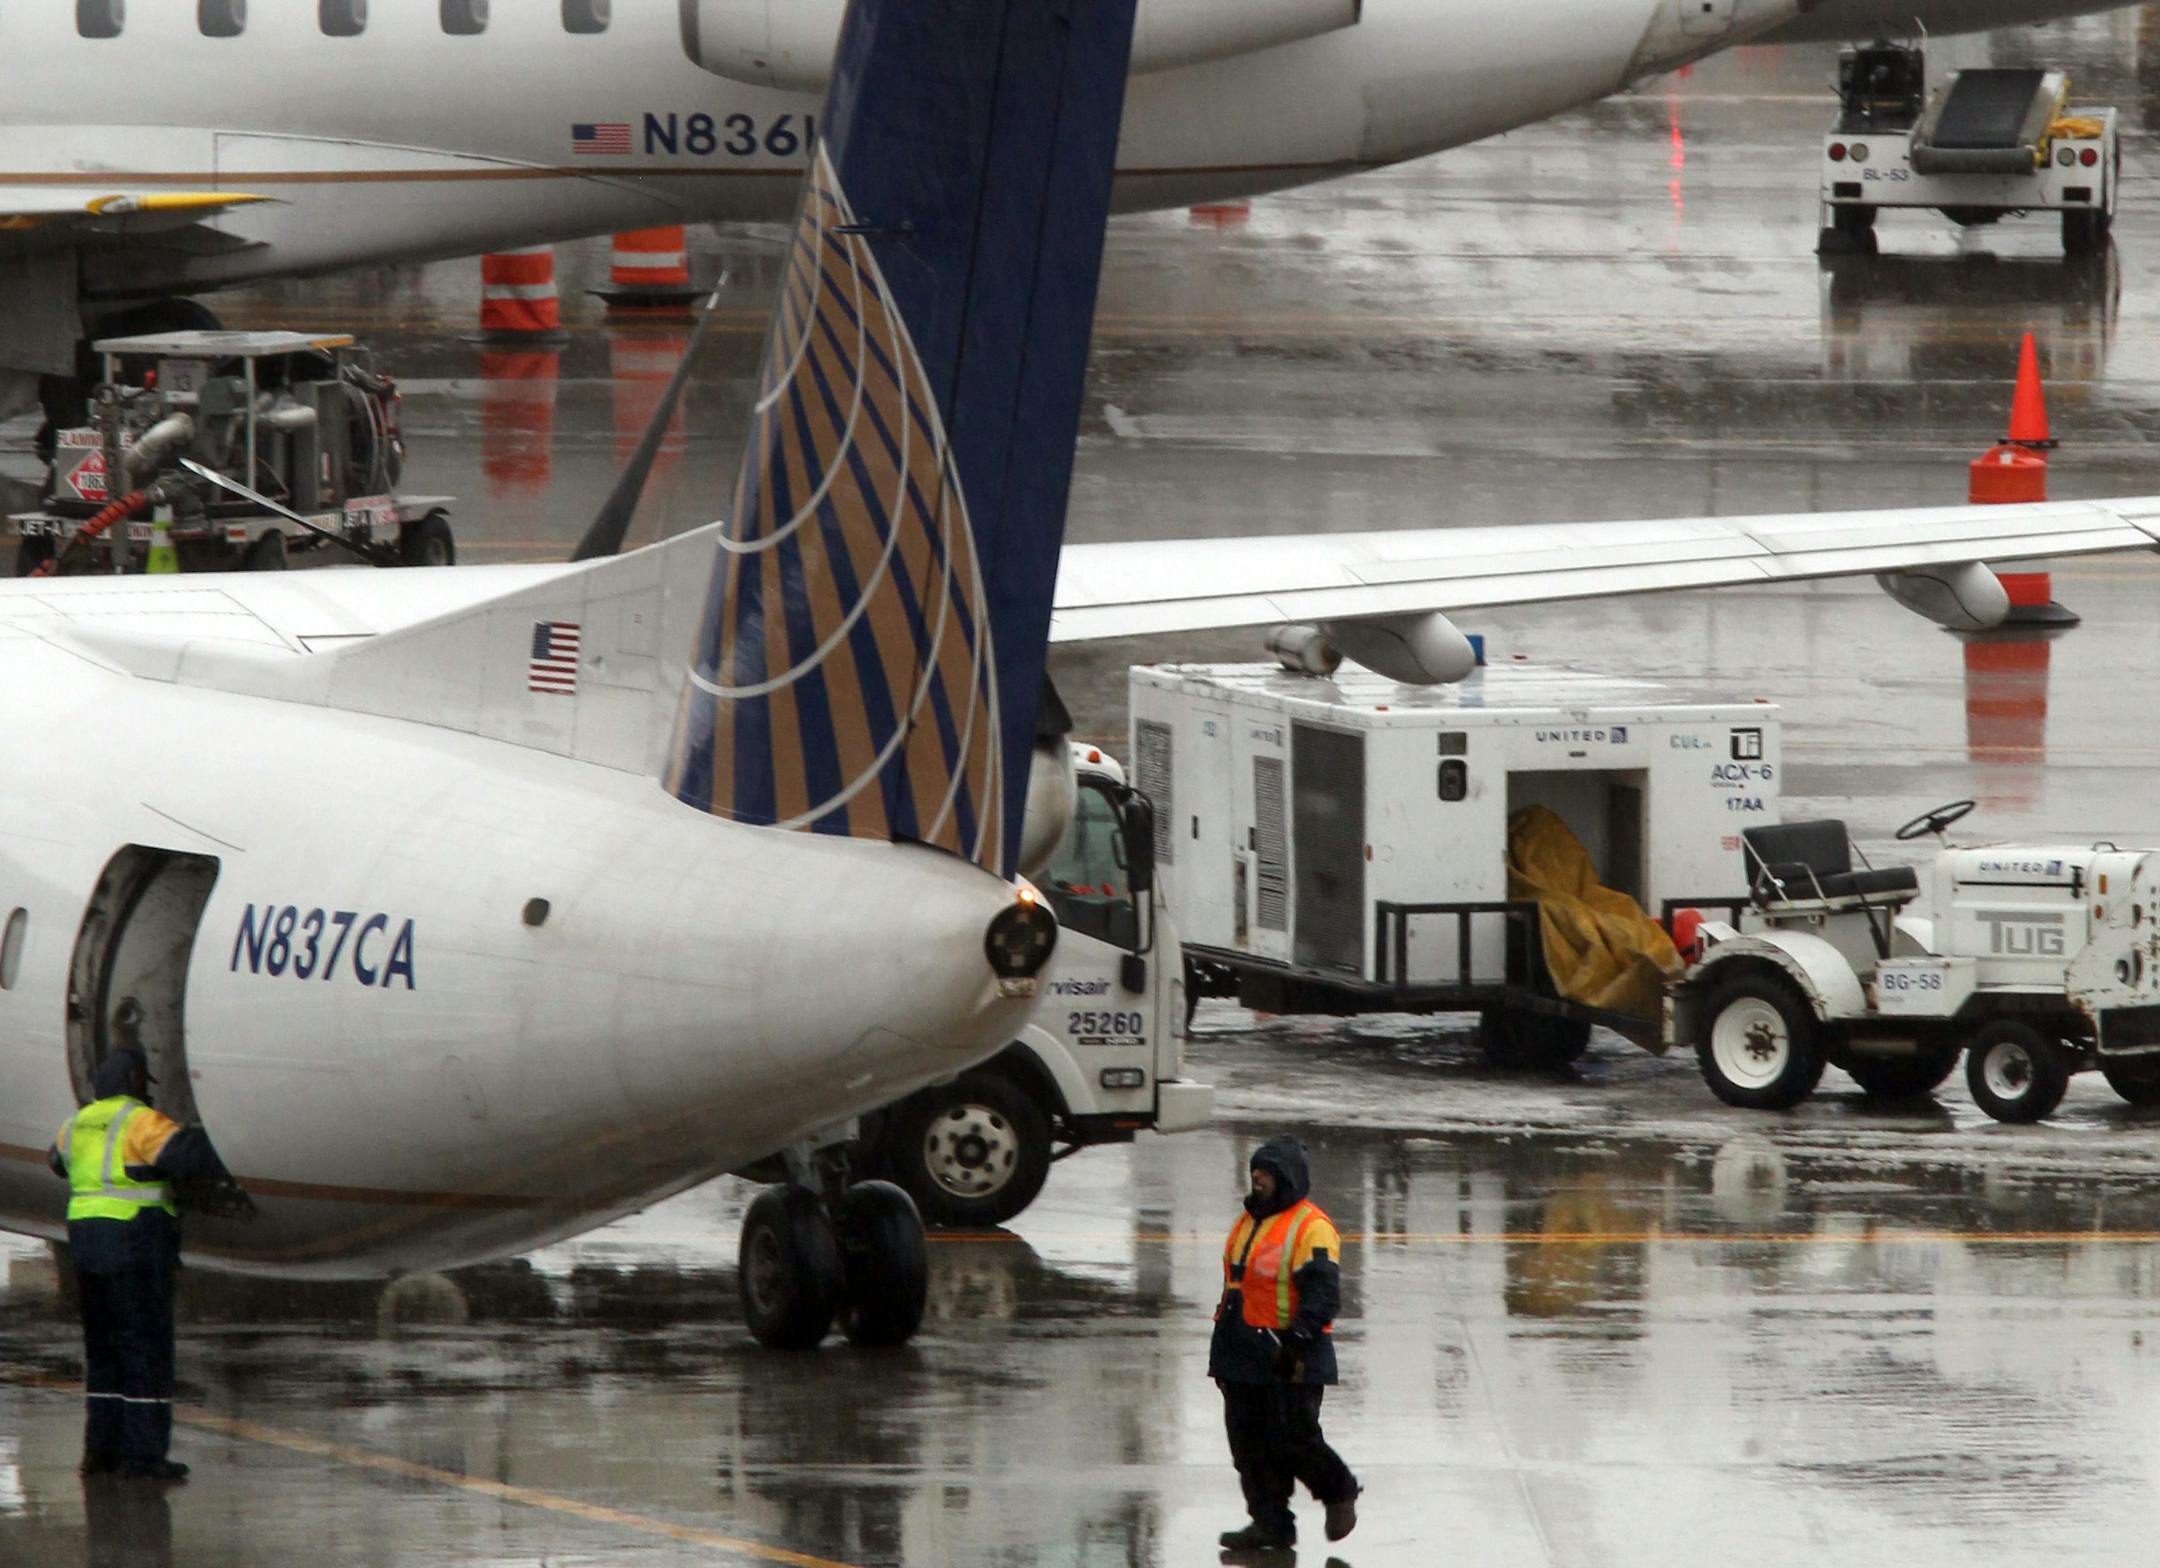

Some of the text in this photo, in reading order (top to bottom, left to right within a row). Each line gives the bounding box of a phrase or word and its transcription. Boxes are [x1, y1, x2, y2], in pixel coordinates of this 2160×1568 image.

[1863, 168, 1908, 181] BL-53
[1535, 730, 1605, 742] UNITED
[1711, 764, 1773, 780] ACX-6
[1726, 798, 1765, 811] 17AA
[1979, 861, 2043, 874] UNITED
[1976, 910, 2064, 955] TUG
[230, 903, 416, 990] N837CA
[1069, 1011, 1142, 1034] 25260
